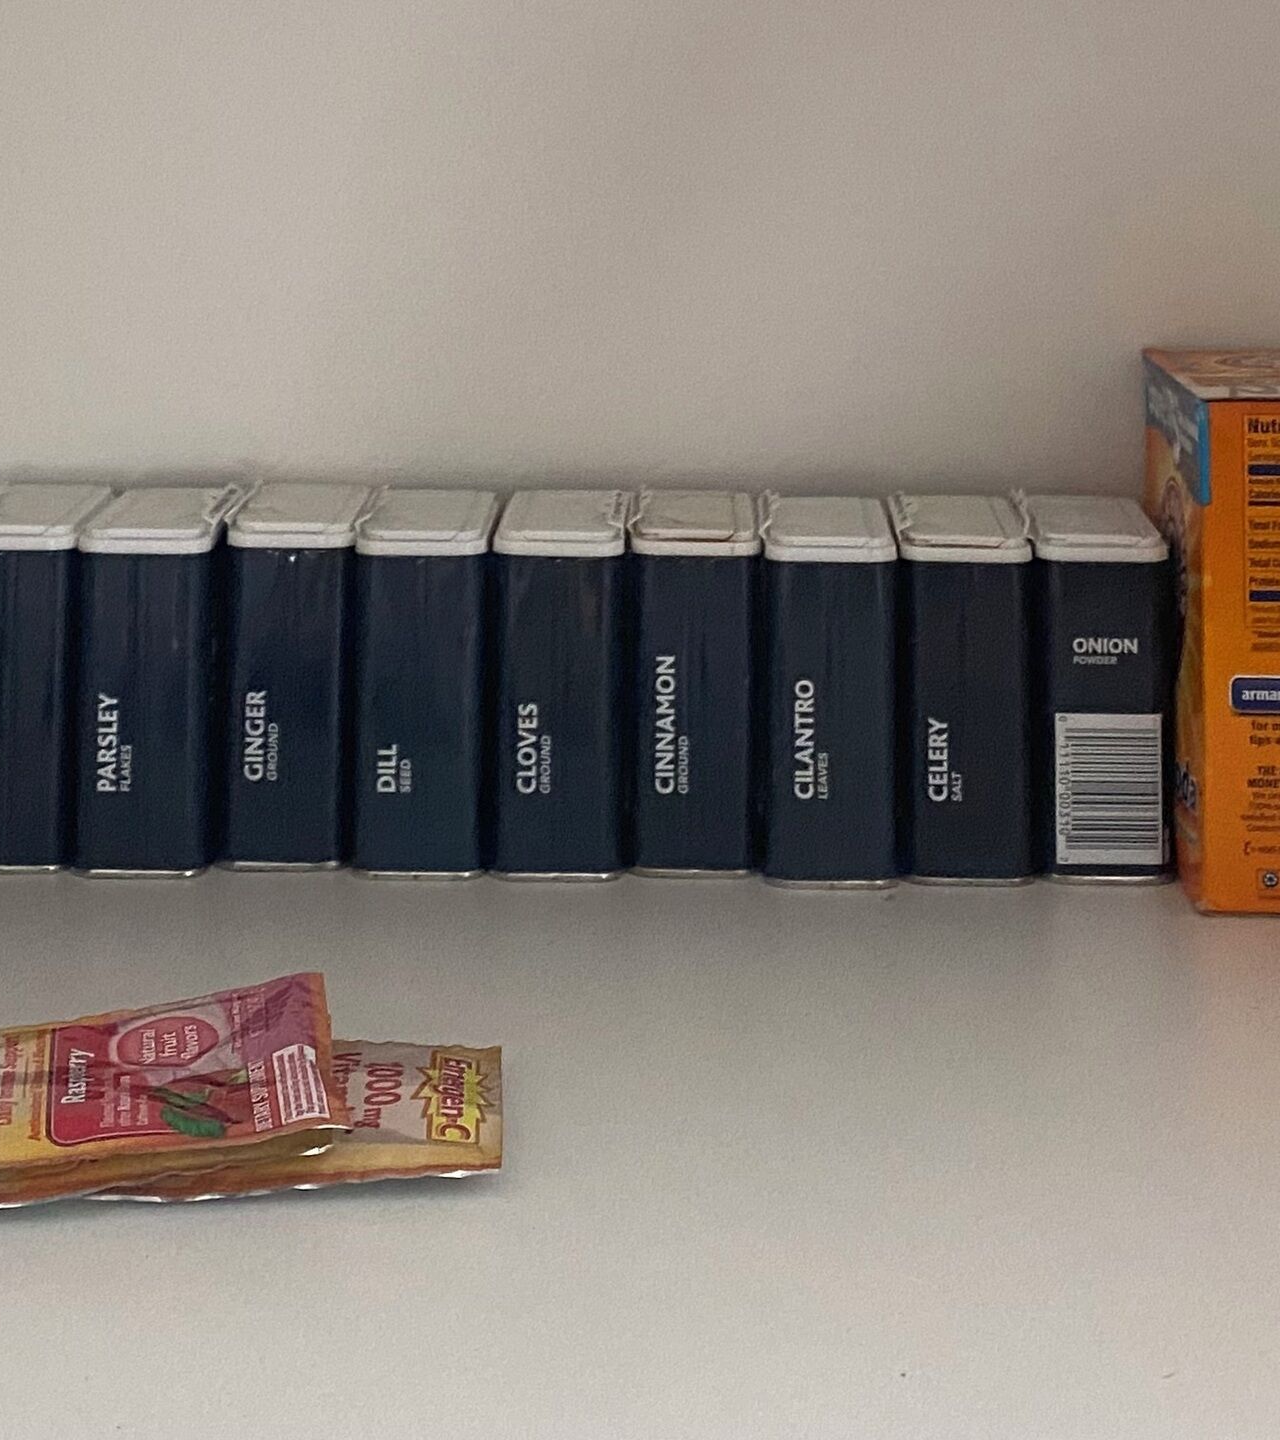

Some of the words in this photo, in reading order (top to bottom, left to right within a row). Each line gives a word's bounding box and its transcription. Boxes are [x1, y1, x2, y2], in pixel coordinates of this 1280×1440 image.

[1072, 637, 1139, 655] ONION
[1073, 656, 1118, 666] POWDER
[97, 692, 119, 792] PARSLEY
[243, 690, 268, 782] GINGER
[516, 702, 539, 794] CLOVES
[655, 655, 677, 795] CINNAMON
[794, 679, 815, 800] CILANTRO
[1250, 735, 1271, 747] tips
[1252, 720, 1268, 731] for
[120, 744, 132, 792] FLAKES
[266, 722, 279, 782] GROUND
[377, 743, 398, 794] DILL
[399, 758, 413, 794] SEED
[539, 734, 552, 794] GROUND
[678, 734, 690, 795] GROUND
[817, 752, 829, 800] LEAVES
[928, 716, 949, 802] CELERY
[1258, 766, 1276, 776] THE
[951, 772, 963, 802] SALT
[158, 1031, 179, 1059] fruit
[180, 1023, 201, 1062] flavors
